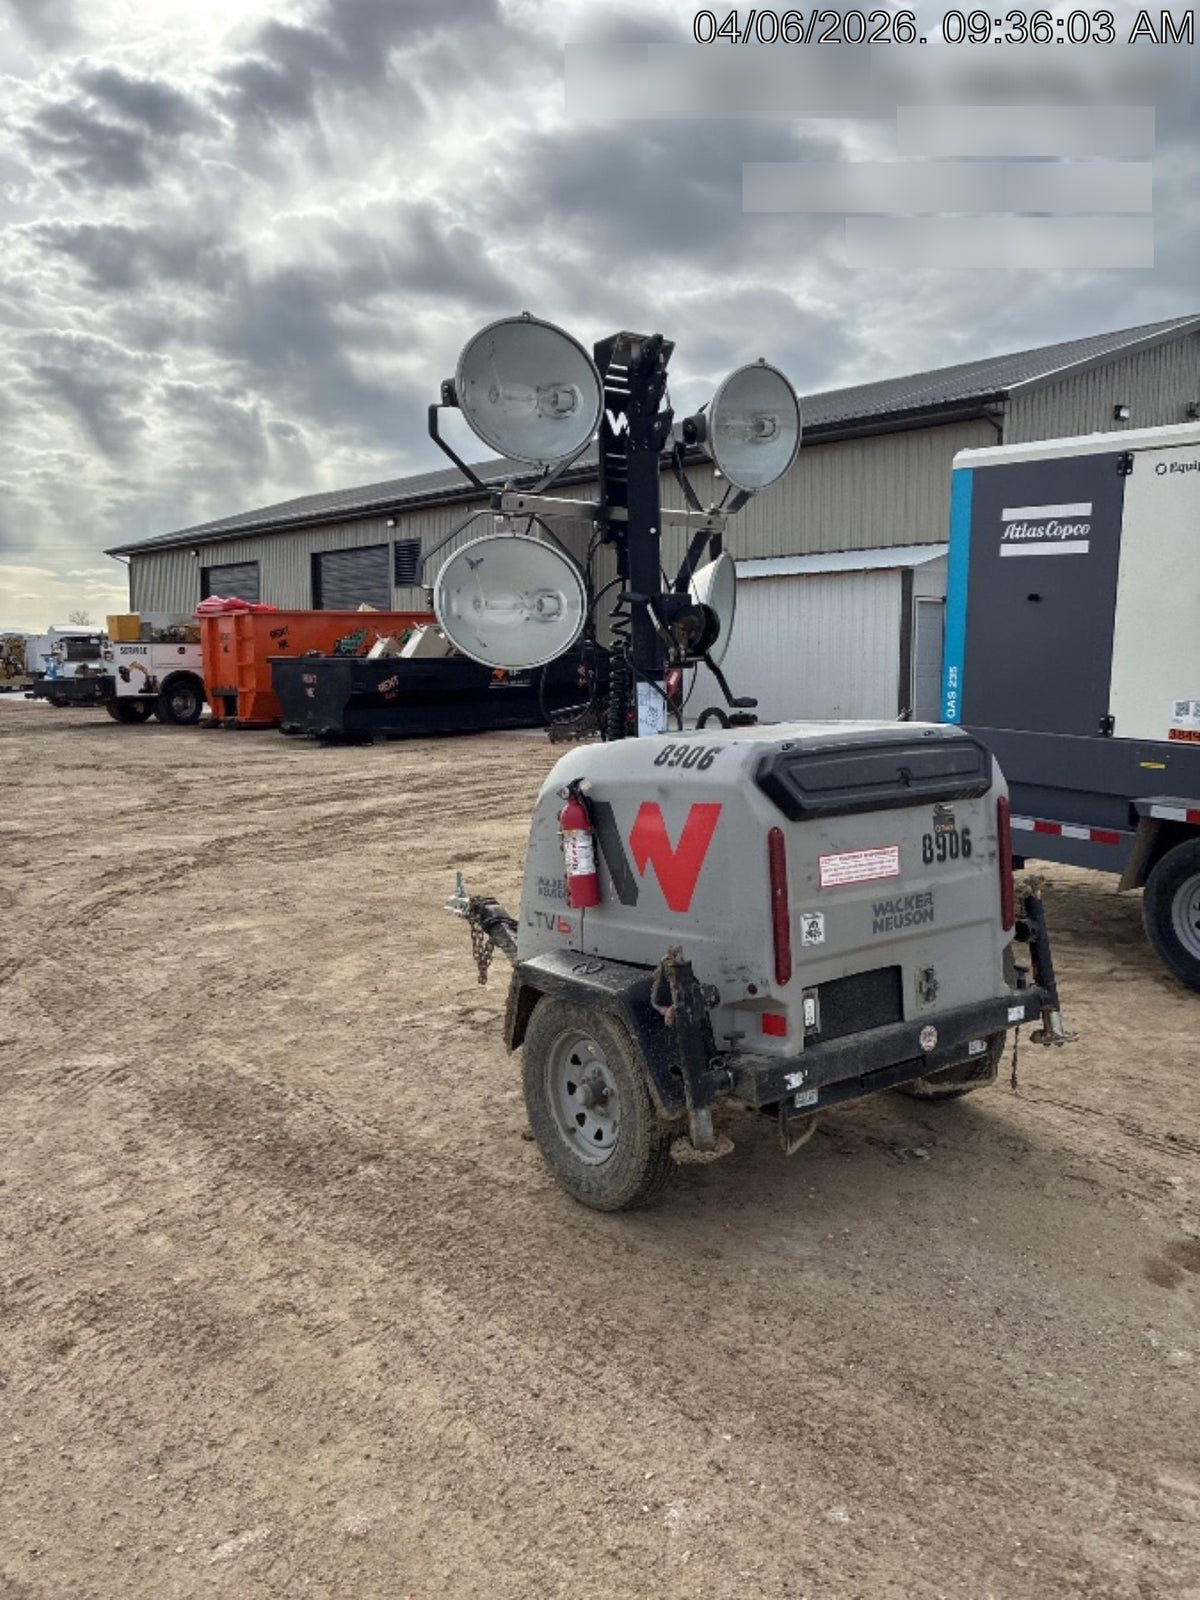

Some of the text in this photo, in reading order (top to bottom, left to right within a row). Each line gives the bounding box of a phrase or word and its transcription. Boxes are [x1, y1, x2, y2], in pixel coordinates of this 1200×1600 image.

[946, 690, 957, 719] QAS
[653, 743, 724, 771] 8906
[922, 827, 972, 865] 8906
[872, 891, 934, 918] WACKER
[872, 907, 934, 934] NEUSON
